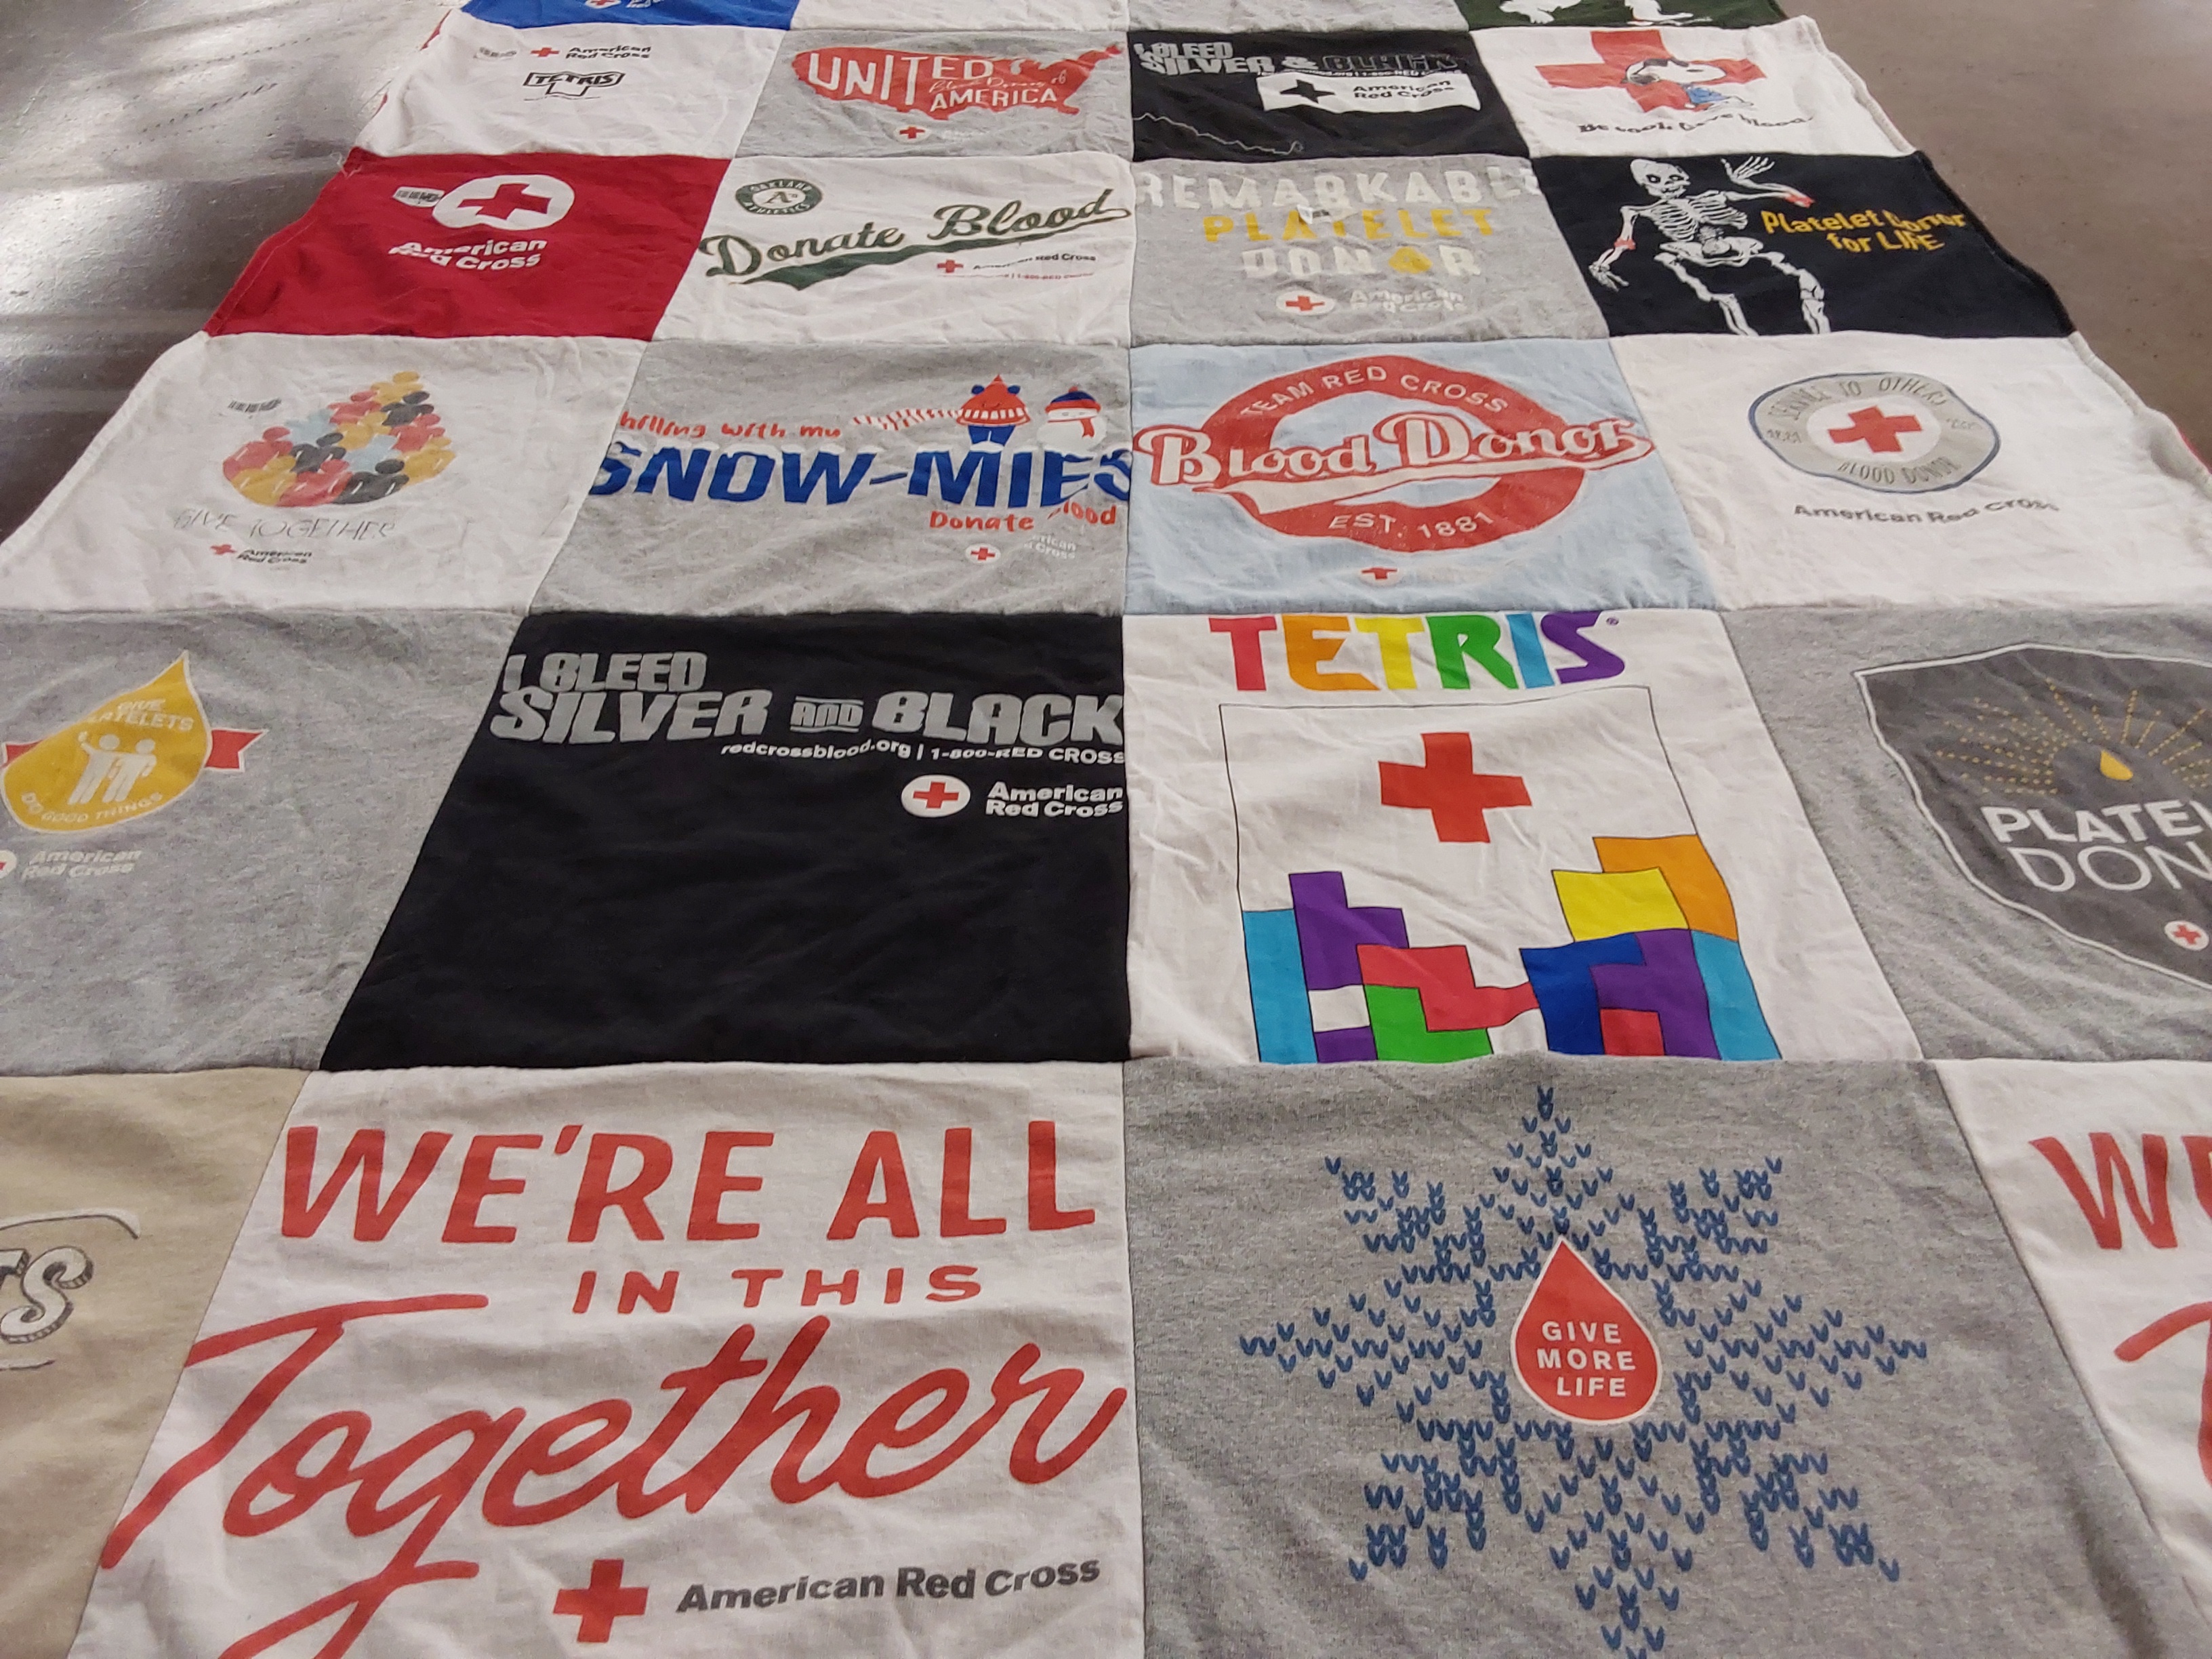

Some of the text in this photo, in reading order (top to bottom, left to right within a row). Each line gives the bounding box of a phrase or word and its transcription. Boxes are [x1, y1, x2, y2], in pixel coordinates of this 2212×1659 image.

[1151, 42, 1233, 59] BLEED
[1139, 51, 1275, 75] SILVER
[535, 73, 615, 85] TETRIS
[807, 53, 994, 105] UNITED
[1353, 80, 1452, 92] American
[930, 88, 1057, 112] AMERICA
[1354, 87, 1456, 100] Red Cross
[699, 188, 1115, 276] Donate Blood
[1761, 209, 1885, 234] Platelet
[398, 240, 548, 255] American
[1826, 230, 1946, 252] for LIFE
[456, 253, 541, 270] Cross
[1036, 253, 1059, 261] Red
[1061, 253, 1097, 261] Cross
[1240, 366, 1509, 419] TEAM RED CROSS
[721, 422, 785, 438] with
[1133, 424, 1378, 485] Blood
[589, 439, 1131, 508] SNOW-MIES
[929, 500, 1117, 532] Donate lood
[1794, 498, 2060, 524] American Red Cross
[1329, 511, 1496, 539] EST. 1881
[1032, 534, 1076, 552] rican
[1208, 610, 1626, 692] TETRIS
[503, 651, 708, 695] I BLEED
[87, 710, 194, 732] ATELETS
[490, 687, 1124, 746] SILVER AND BLACK
[720, 738, 912, 760] redcrossblood.org
[930, 746, 1043, 761] 1-800-RED
[1049, 748, 1124, 765] CROSS
[987, 781, 1124, 803] American
[985, 800, 1124, 817] Red Cross
[29, 849, 142, 866] American
[279, 1120, 1095, 1244] WE'RE ALL
[573, 1265, 982, 1315] IN THIS
[1542, 1321, 1622, 1345] GIVE
[1536, 1347, 1636, 1371] MORE
[1557, 1376, 1626, 1397] LIFE
[100, 1294, 1127, 1659] Together
[676, 1559, 1101, 1614] American Red Cross
